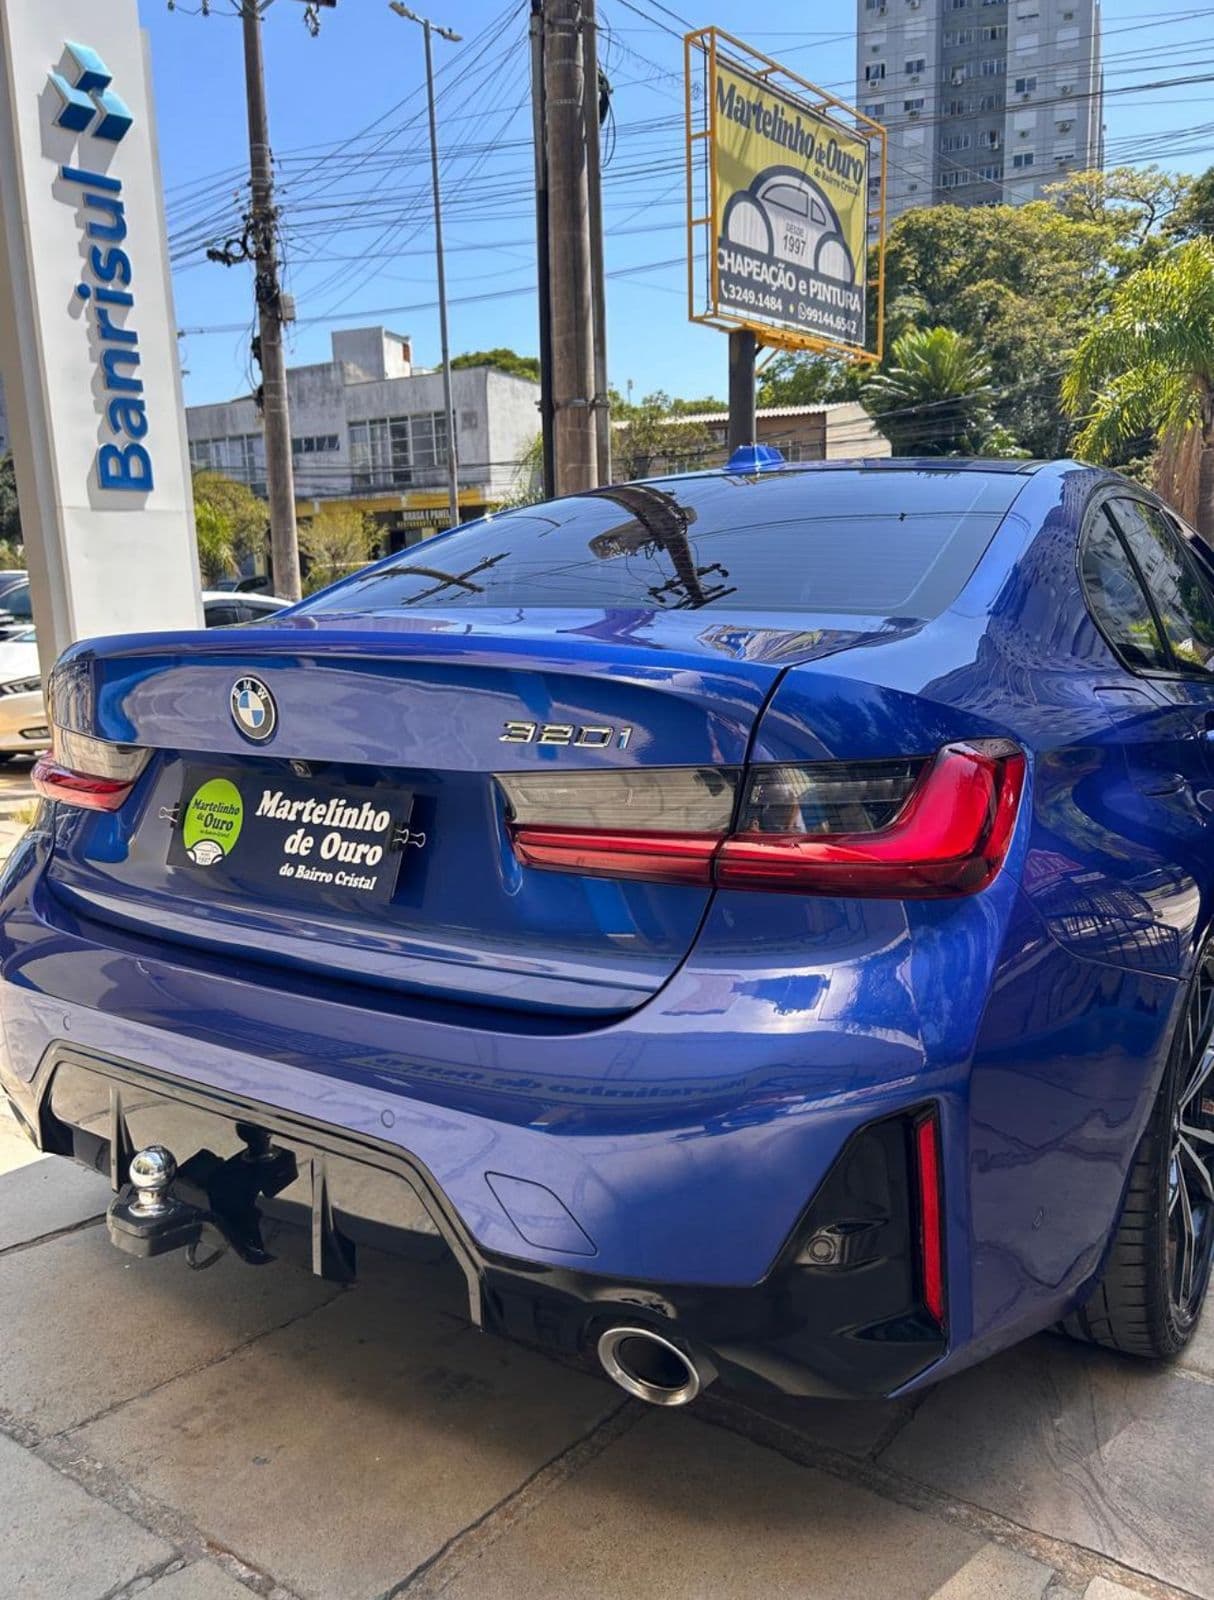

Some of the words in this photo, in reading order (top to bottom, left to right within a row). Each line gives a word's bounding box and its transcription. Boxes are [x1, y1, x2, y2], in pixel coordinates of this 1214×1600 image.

[715, 76, 814, 168] Martelinho
[815, 142, 826, 166] de
[827, 138, 863, 185] Ouro
[783, 234, 806, 256] 1997
[716, 248, 796, 292] CHAPEAÇÃO
[798, 280, 807, 295] e
[809, 279, 861, 313] PINTURA
[729, 284, 783, 312] 3249.1484
[59, 166, 154, 491] Banrisul
[192, 799, 240, 816] Martelinho
[204, 813, 234, 831] Ouro
[255, 790, 391, 832] Martelinho
[284, 828, 313, 856] de
[320, 832, 383, 866] Ouro
[279, 863, 293, 877] do
[295, 865, 333, 884] Bairro
[334, 871, 377, 891] Cristal
